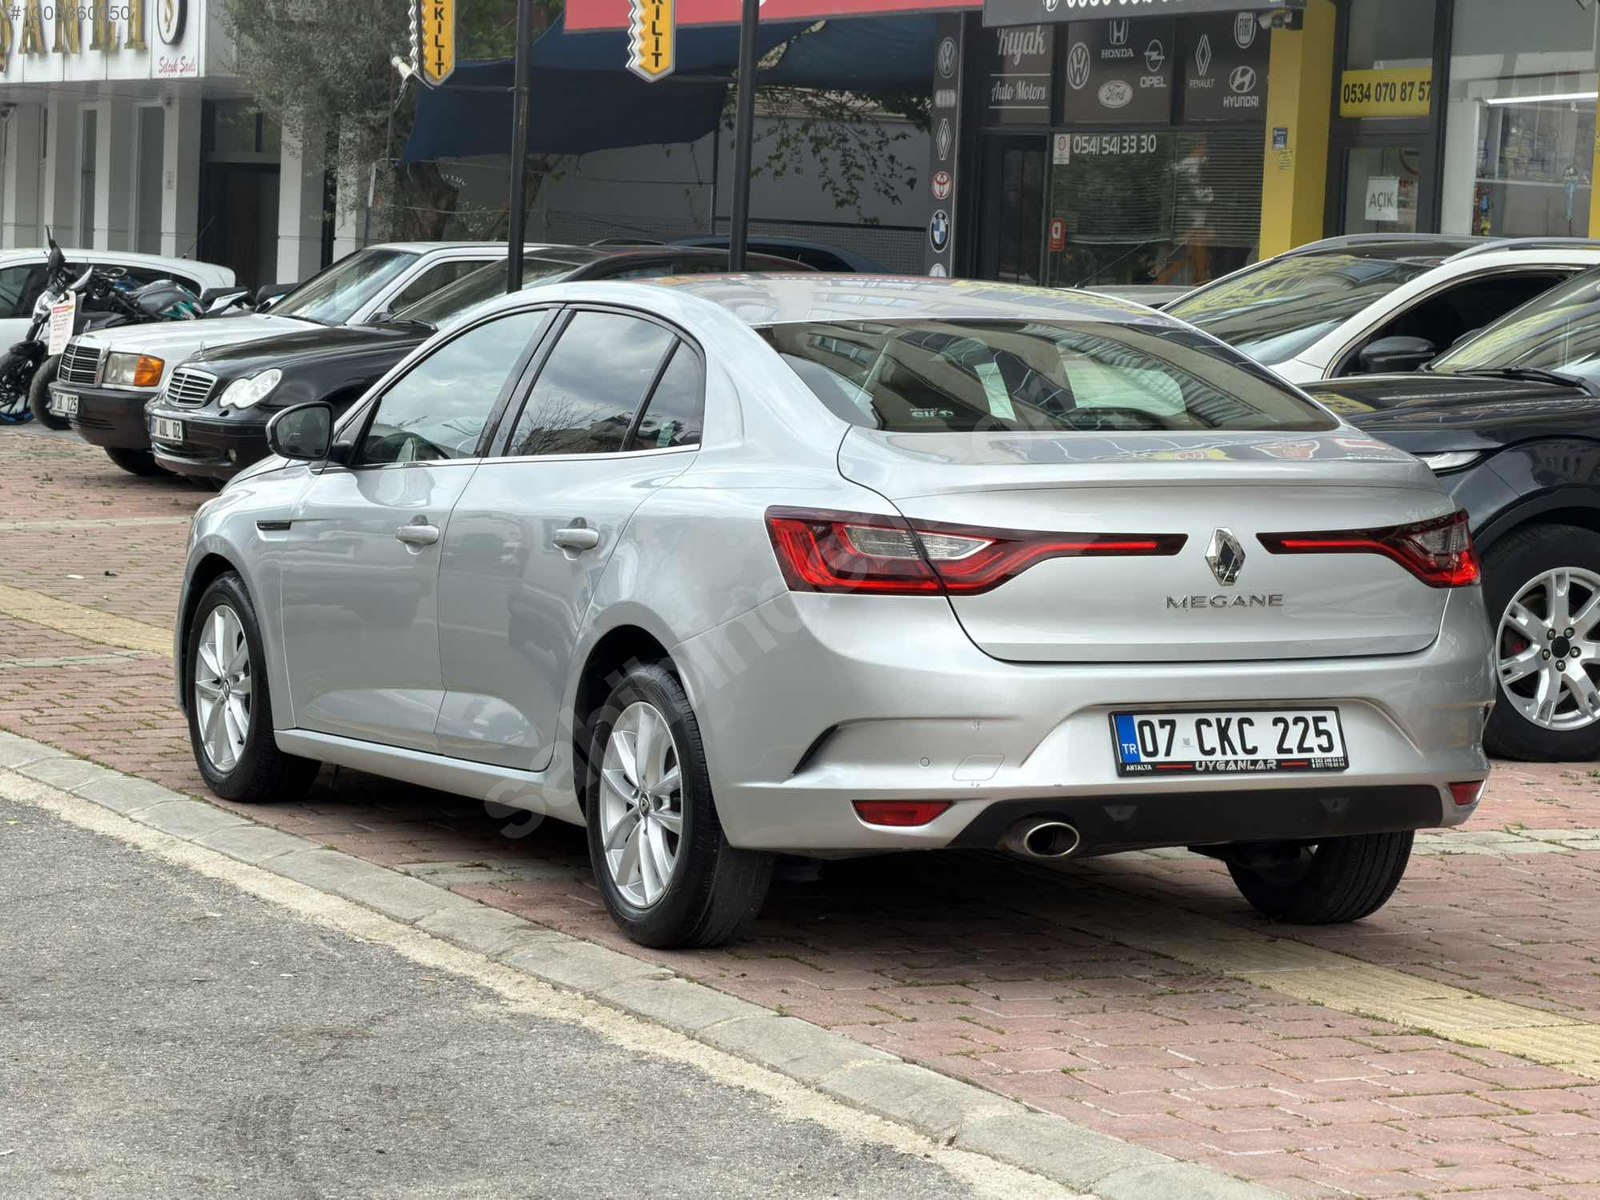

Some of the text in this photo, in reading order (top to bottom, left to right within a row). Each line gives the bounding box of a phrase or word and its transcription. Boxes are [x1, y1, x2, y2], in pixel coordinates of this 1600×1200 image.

[1101, 48, 1134, 58] HONDA
[1139, 76, 1167, 88] OPEL
[1188, 79, 1215, 88] RENAULT
[991, 80, 1046, 102] Auto Motors
[1343, 80, 1433, 103] 0534 070 87 57
[1223, 96, 1259, 108] HYUNDAI
[1073, 136, 1100, 155] 0541
[1121, 135, 1137, 154] 33
[1139, 134, 1157, 154] 30
[1368, 191, 1394, 212] AÇIK
[1165, 593, 1285, 609] MEGANE
[1122, 715, 1335, 758] TR 07 CKC 225
[1195, 759, 1277, 771] UYGANLAR
